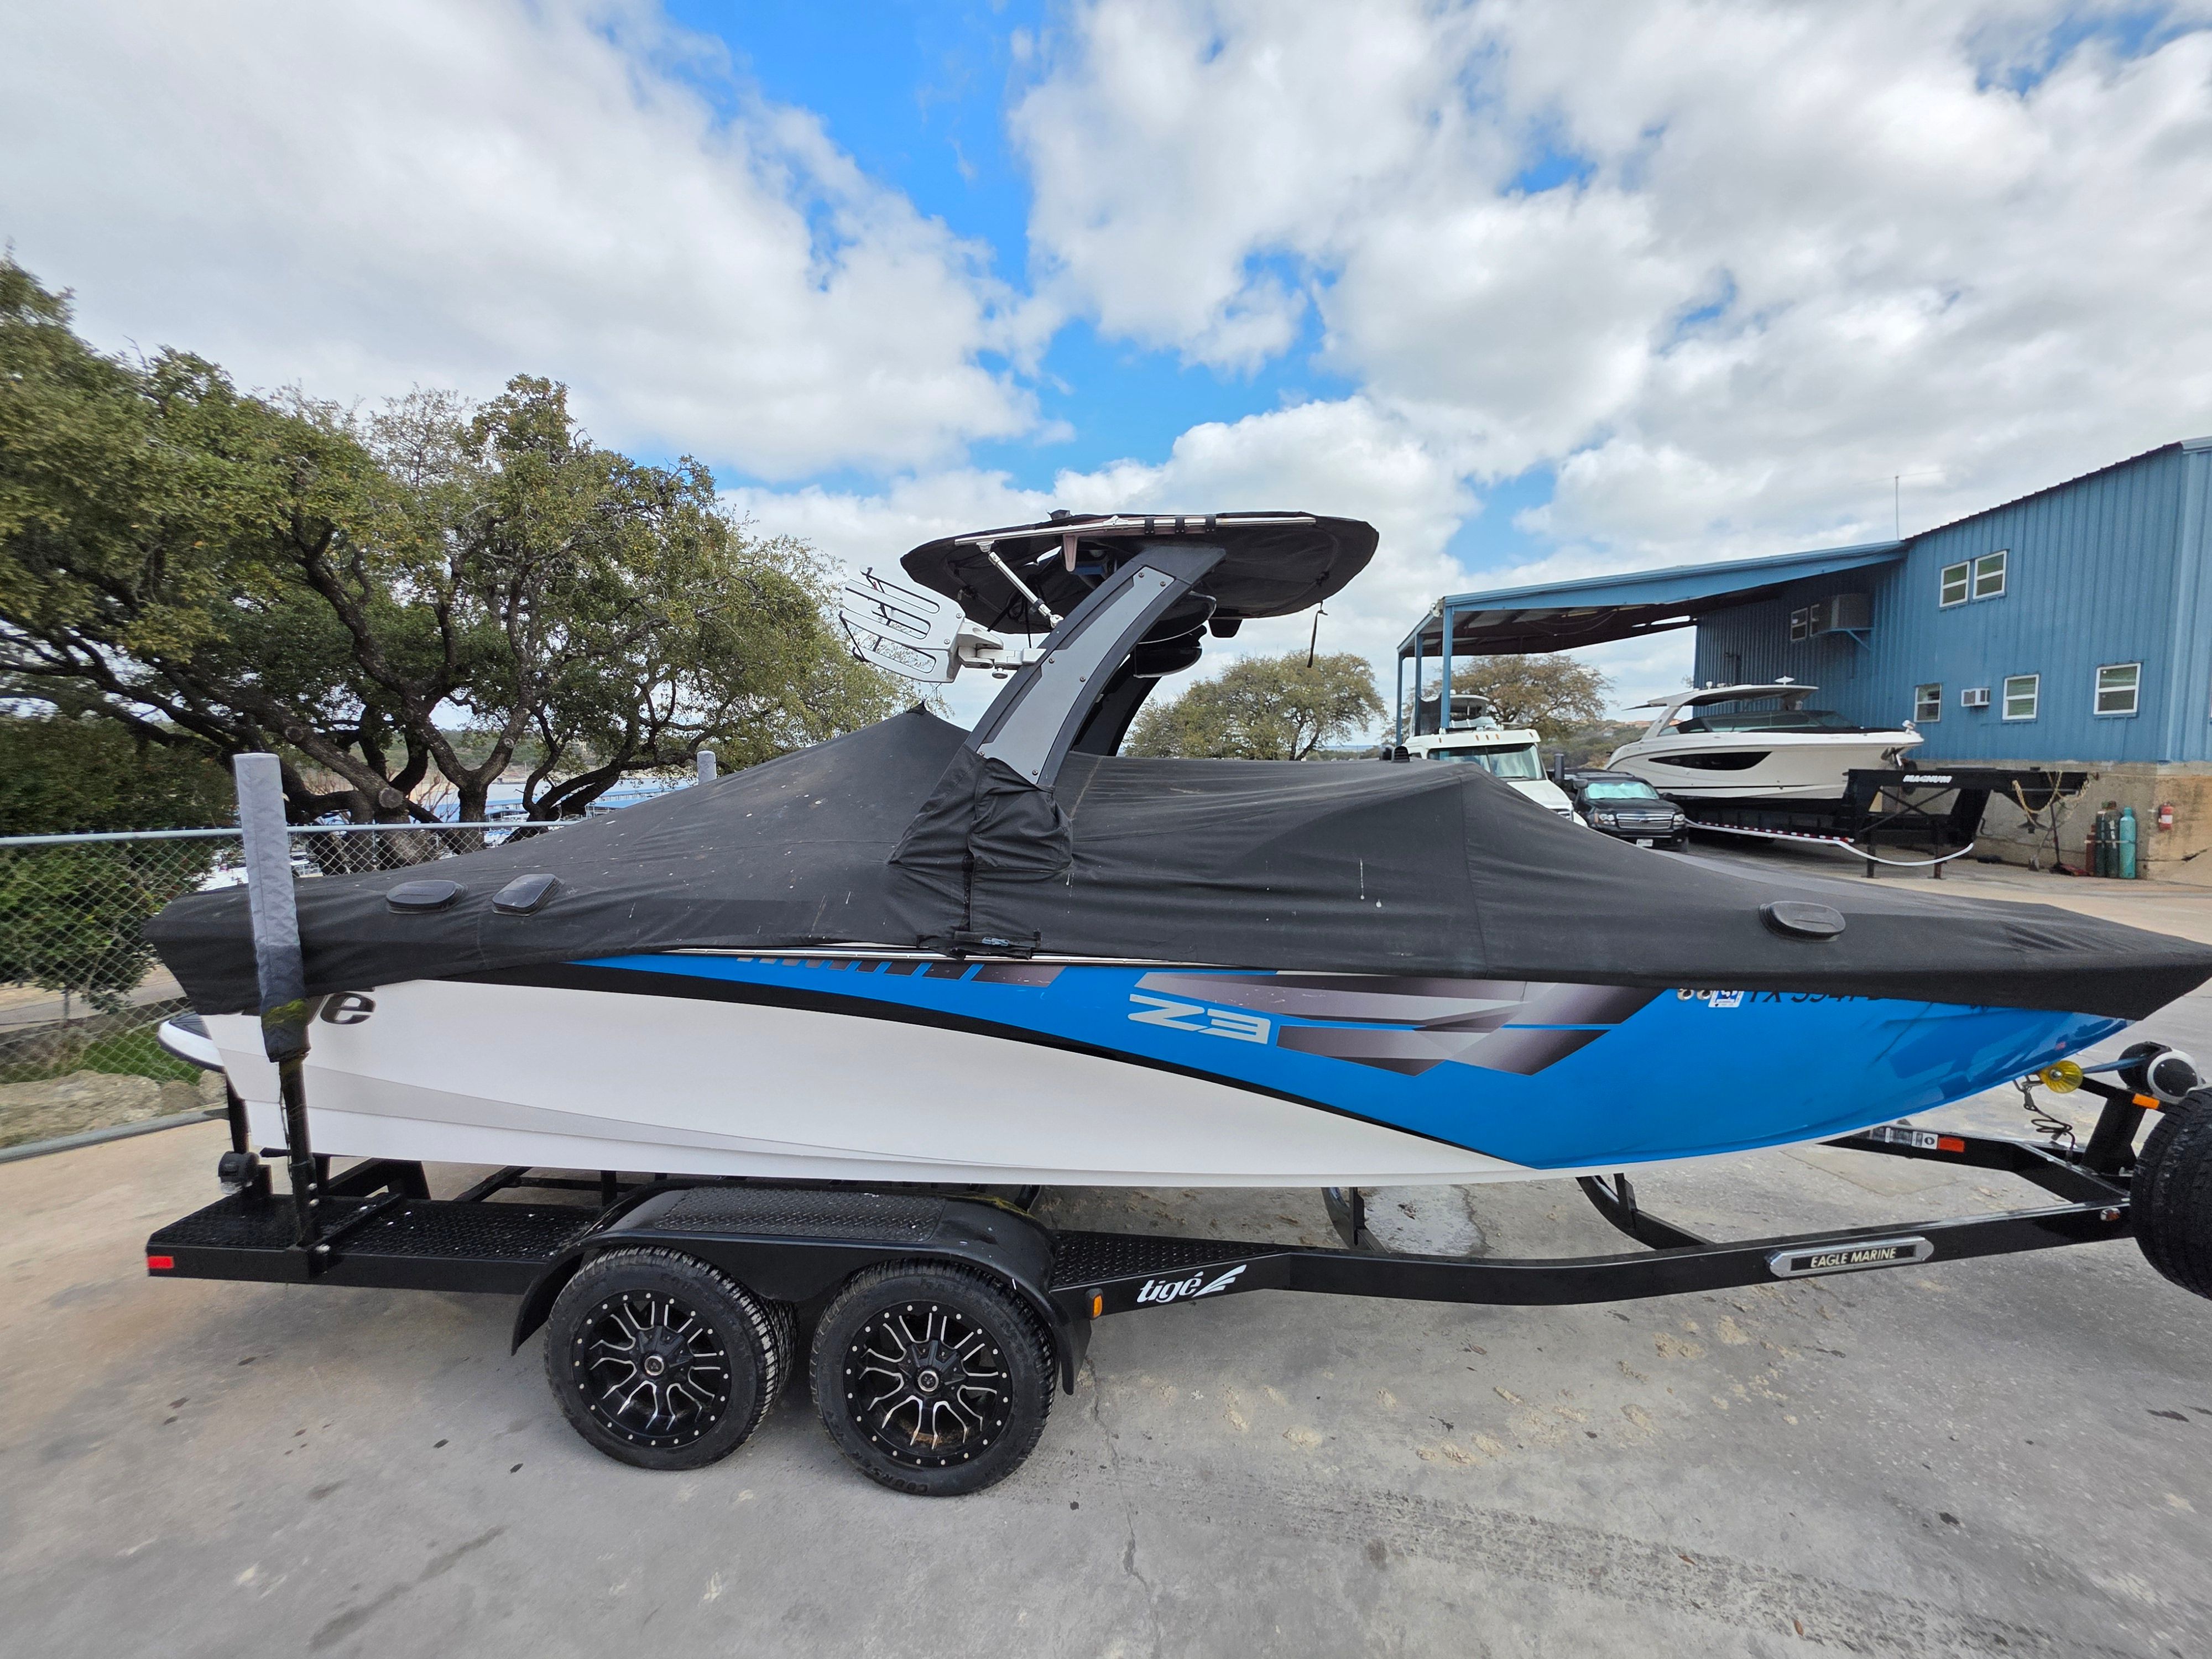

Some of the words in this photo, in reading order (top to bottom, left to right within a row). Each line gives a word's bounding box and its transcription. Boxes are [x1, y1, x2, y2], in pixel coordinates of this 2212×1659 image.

[1127, 993, 1271, 1045] Z3
[1810, 1253, 1848, 1269] EAGLE
[1850, 1247, 1897, 1264] MARINE
